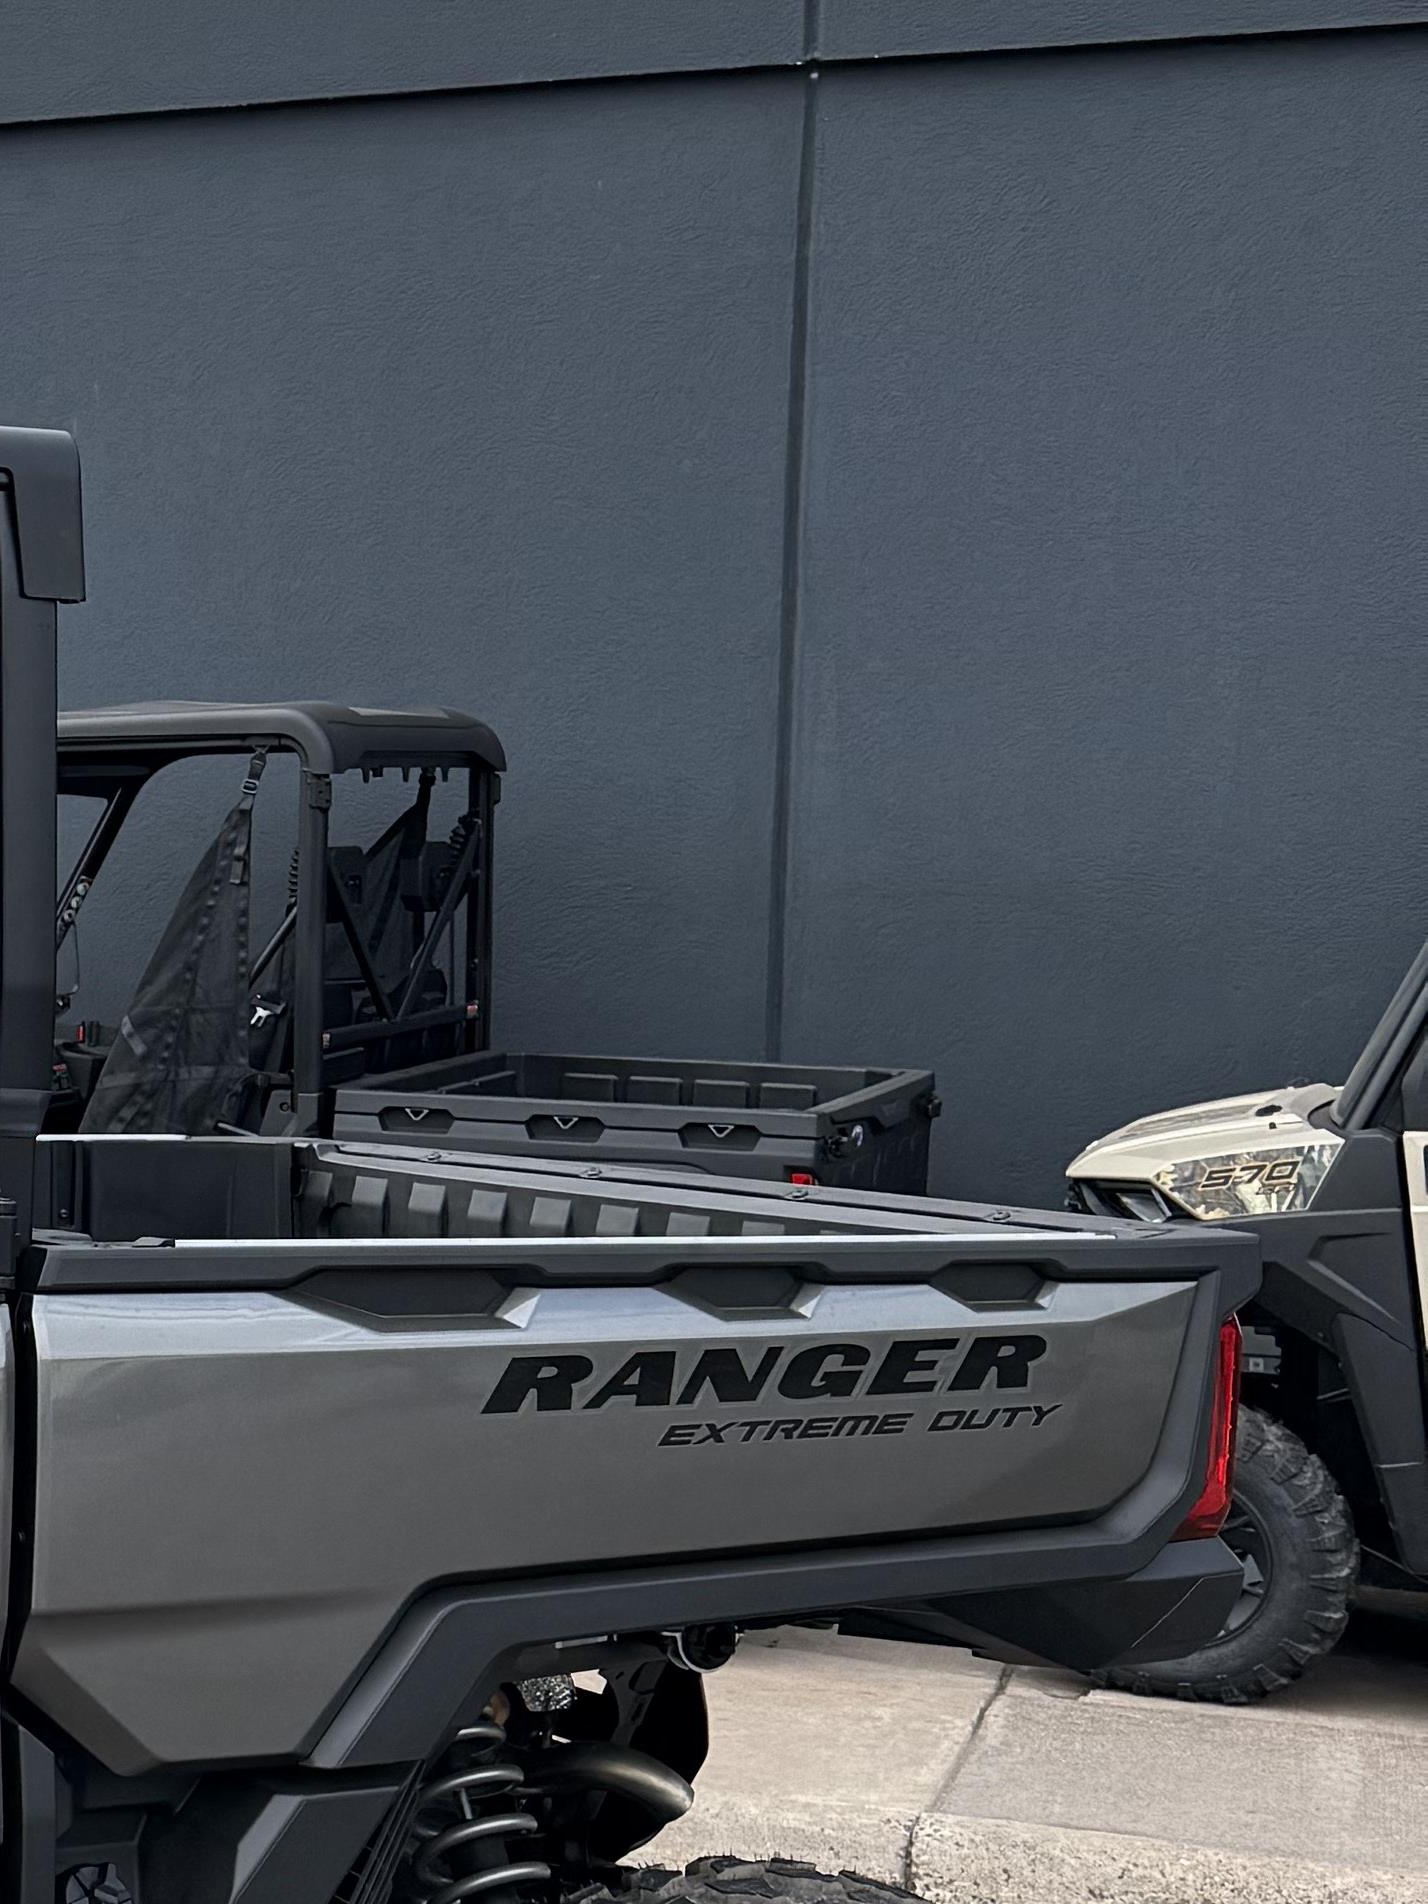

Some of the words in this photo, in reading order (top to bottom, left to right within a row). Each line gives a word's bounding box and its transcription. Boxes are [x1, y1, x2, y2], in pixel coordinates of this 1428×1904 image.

[1200, 1160, 1301, 1189] 570
[480, 1333, 1048, 1415] RANGER
[657, 1413, 911, 1448] EXTREME
[927, 1402, 1064, 1435] DUTY
